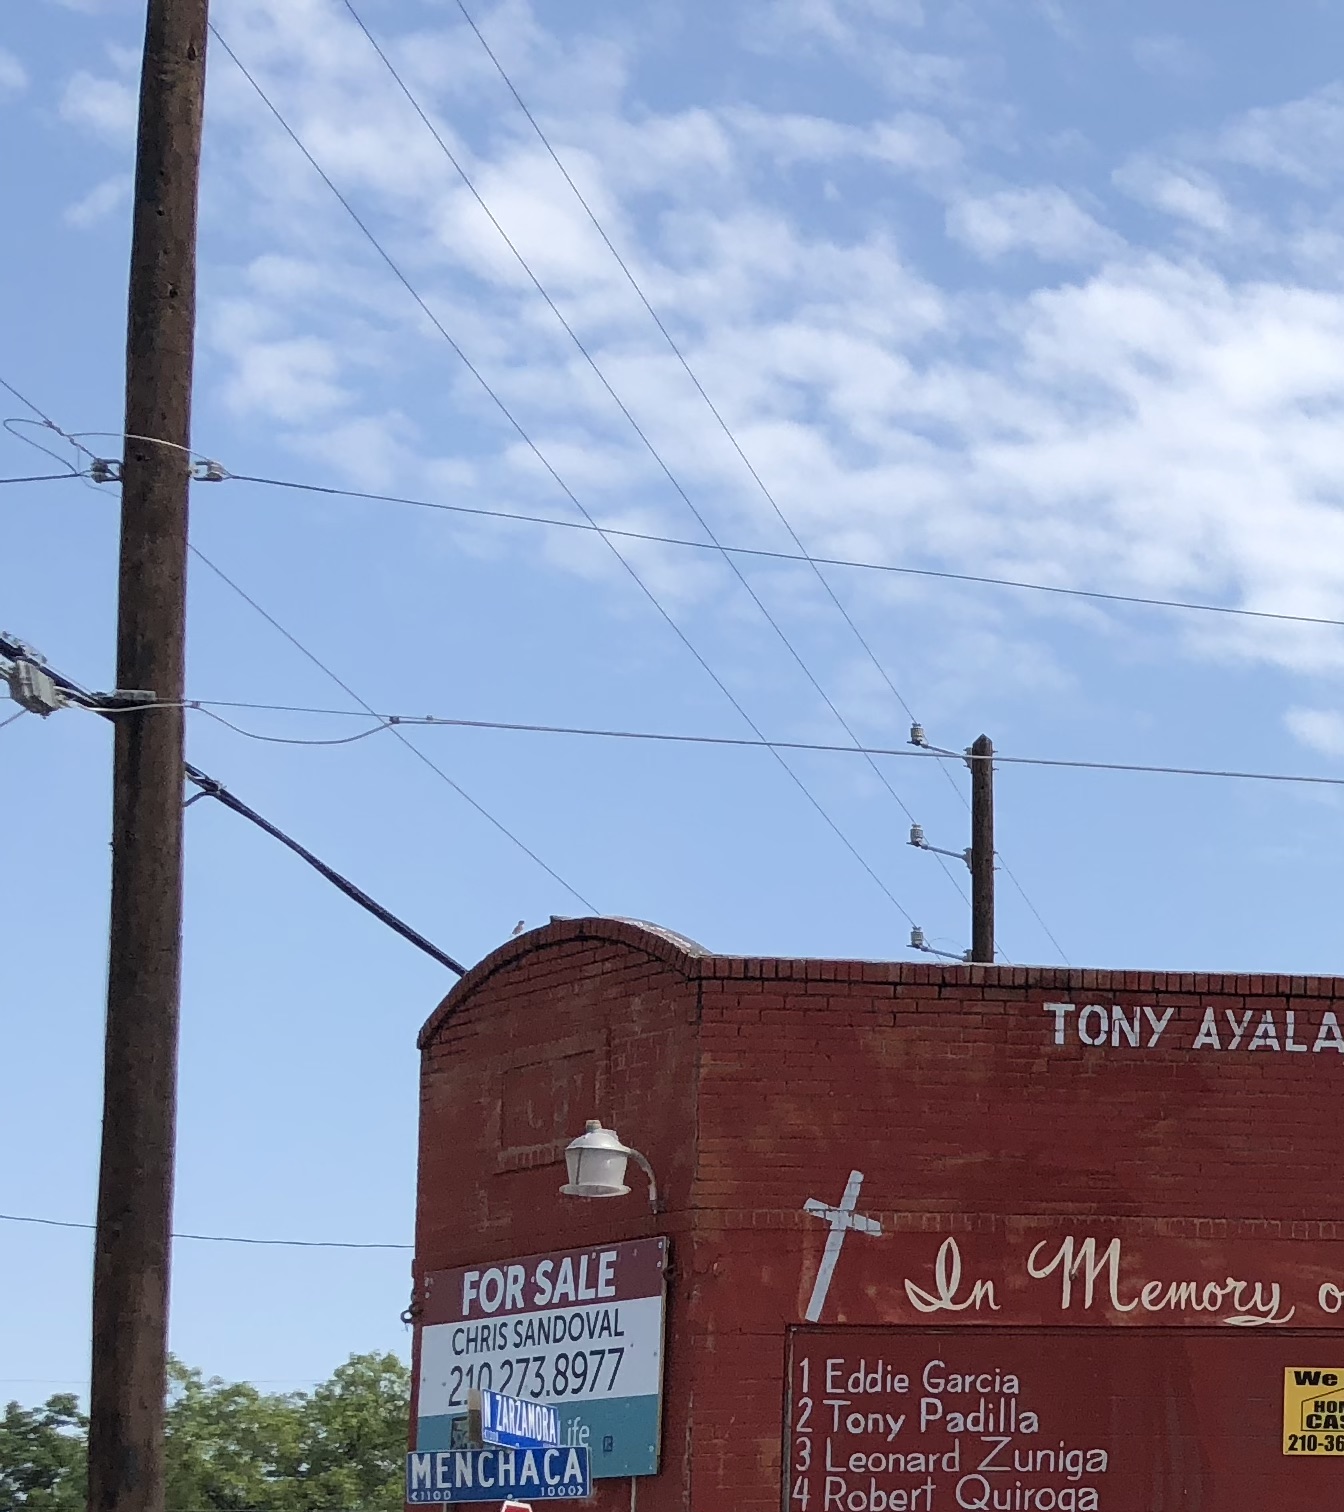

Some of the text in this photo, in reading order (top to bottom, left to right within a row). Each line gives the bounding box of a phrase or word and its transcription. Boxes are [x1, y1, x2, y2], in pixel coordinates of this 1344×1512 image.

[1043, 1002, 1174, 1049] TONY
[462, 1250, 618, 1316] FOR SALE
[904, 1236, 1001, 1313] In
[1027, 1235, 1296, 1326] Memory
[451, 1308, 625, 1356] CHRIS SANDOVAL
[799, 1359, 1020, 1395] 1 Eddie Garcia
[1293, 1371, 1338, 1386] We
[484, 1391, 557, 1444] N ZARZAMORA
[796, 1396, 1039, 1440] 2 Tony Padilla
[410, 1448, 584, 1491] MENCHACA
[795, 1436, 1108, 1480] 3 Leonard Zuniga
[419, 1490, 452, 1501] 1100
[541, 1485, 577, 1497] 1000
[792, 1477, 811, 1509] 4
[824, 1476, 937, 1512] Robert
